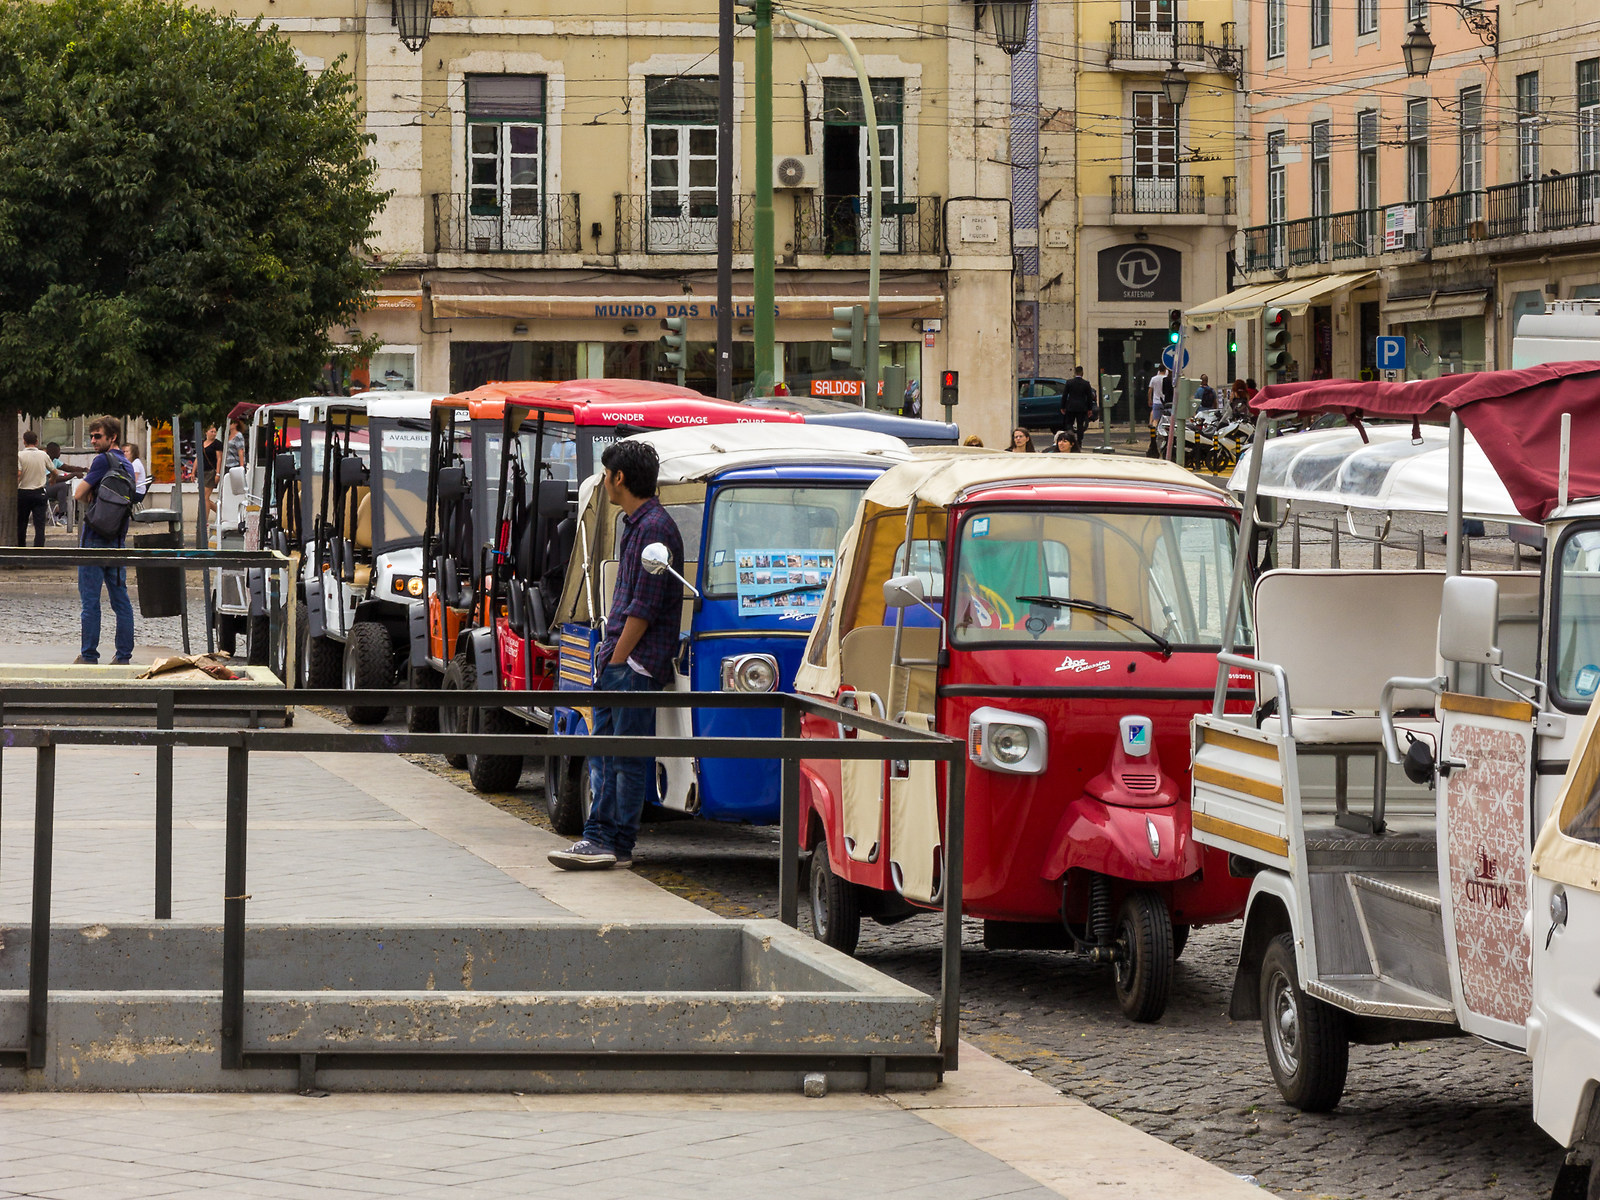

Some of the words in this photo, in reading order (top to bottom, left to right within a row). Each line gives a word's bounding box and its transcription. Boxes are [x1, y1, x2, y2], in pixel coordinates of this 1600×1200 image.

[595, 304, 657, 317] MUNDO
[667, 304, 699, 317] DAS
[1384, 341, 1399, 365] P
[815, 380, 857, 394] SALDOS
[602, 412, 644, 422] WONDER
[667, 415, 709, 424] VOLTAGE
[592, 435, 615, 444] (+351)
[1466, 879, 1510, 910] CITYTUK
